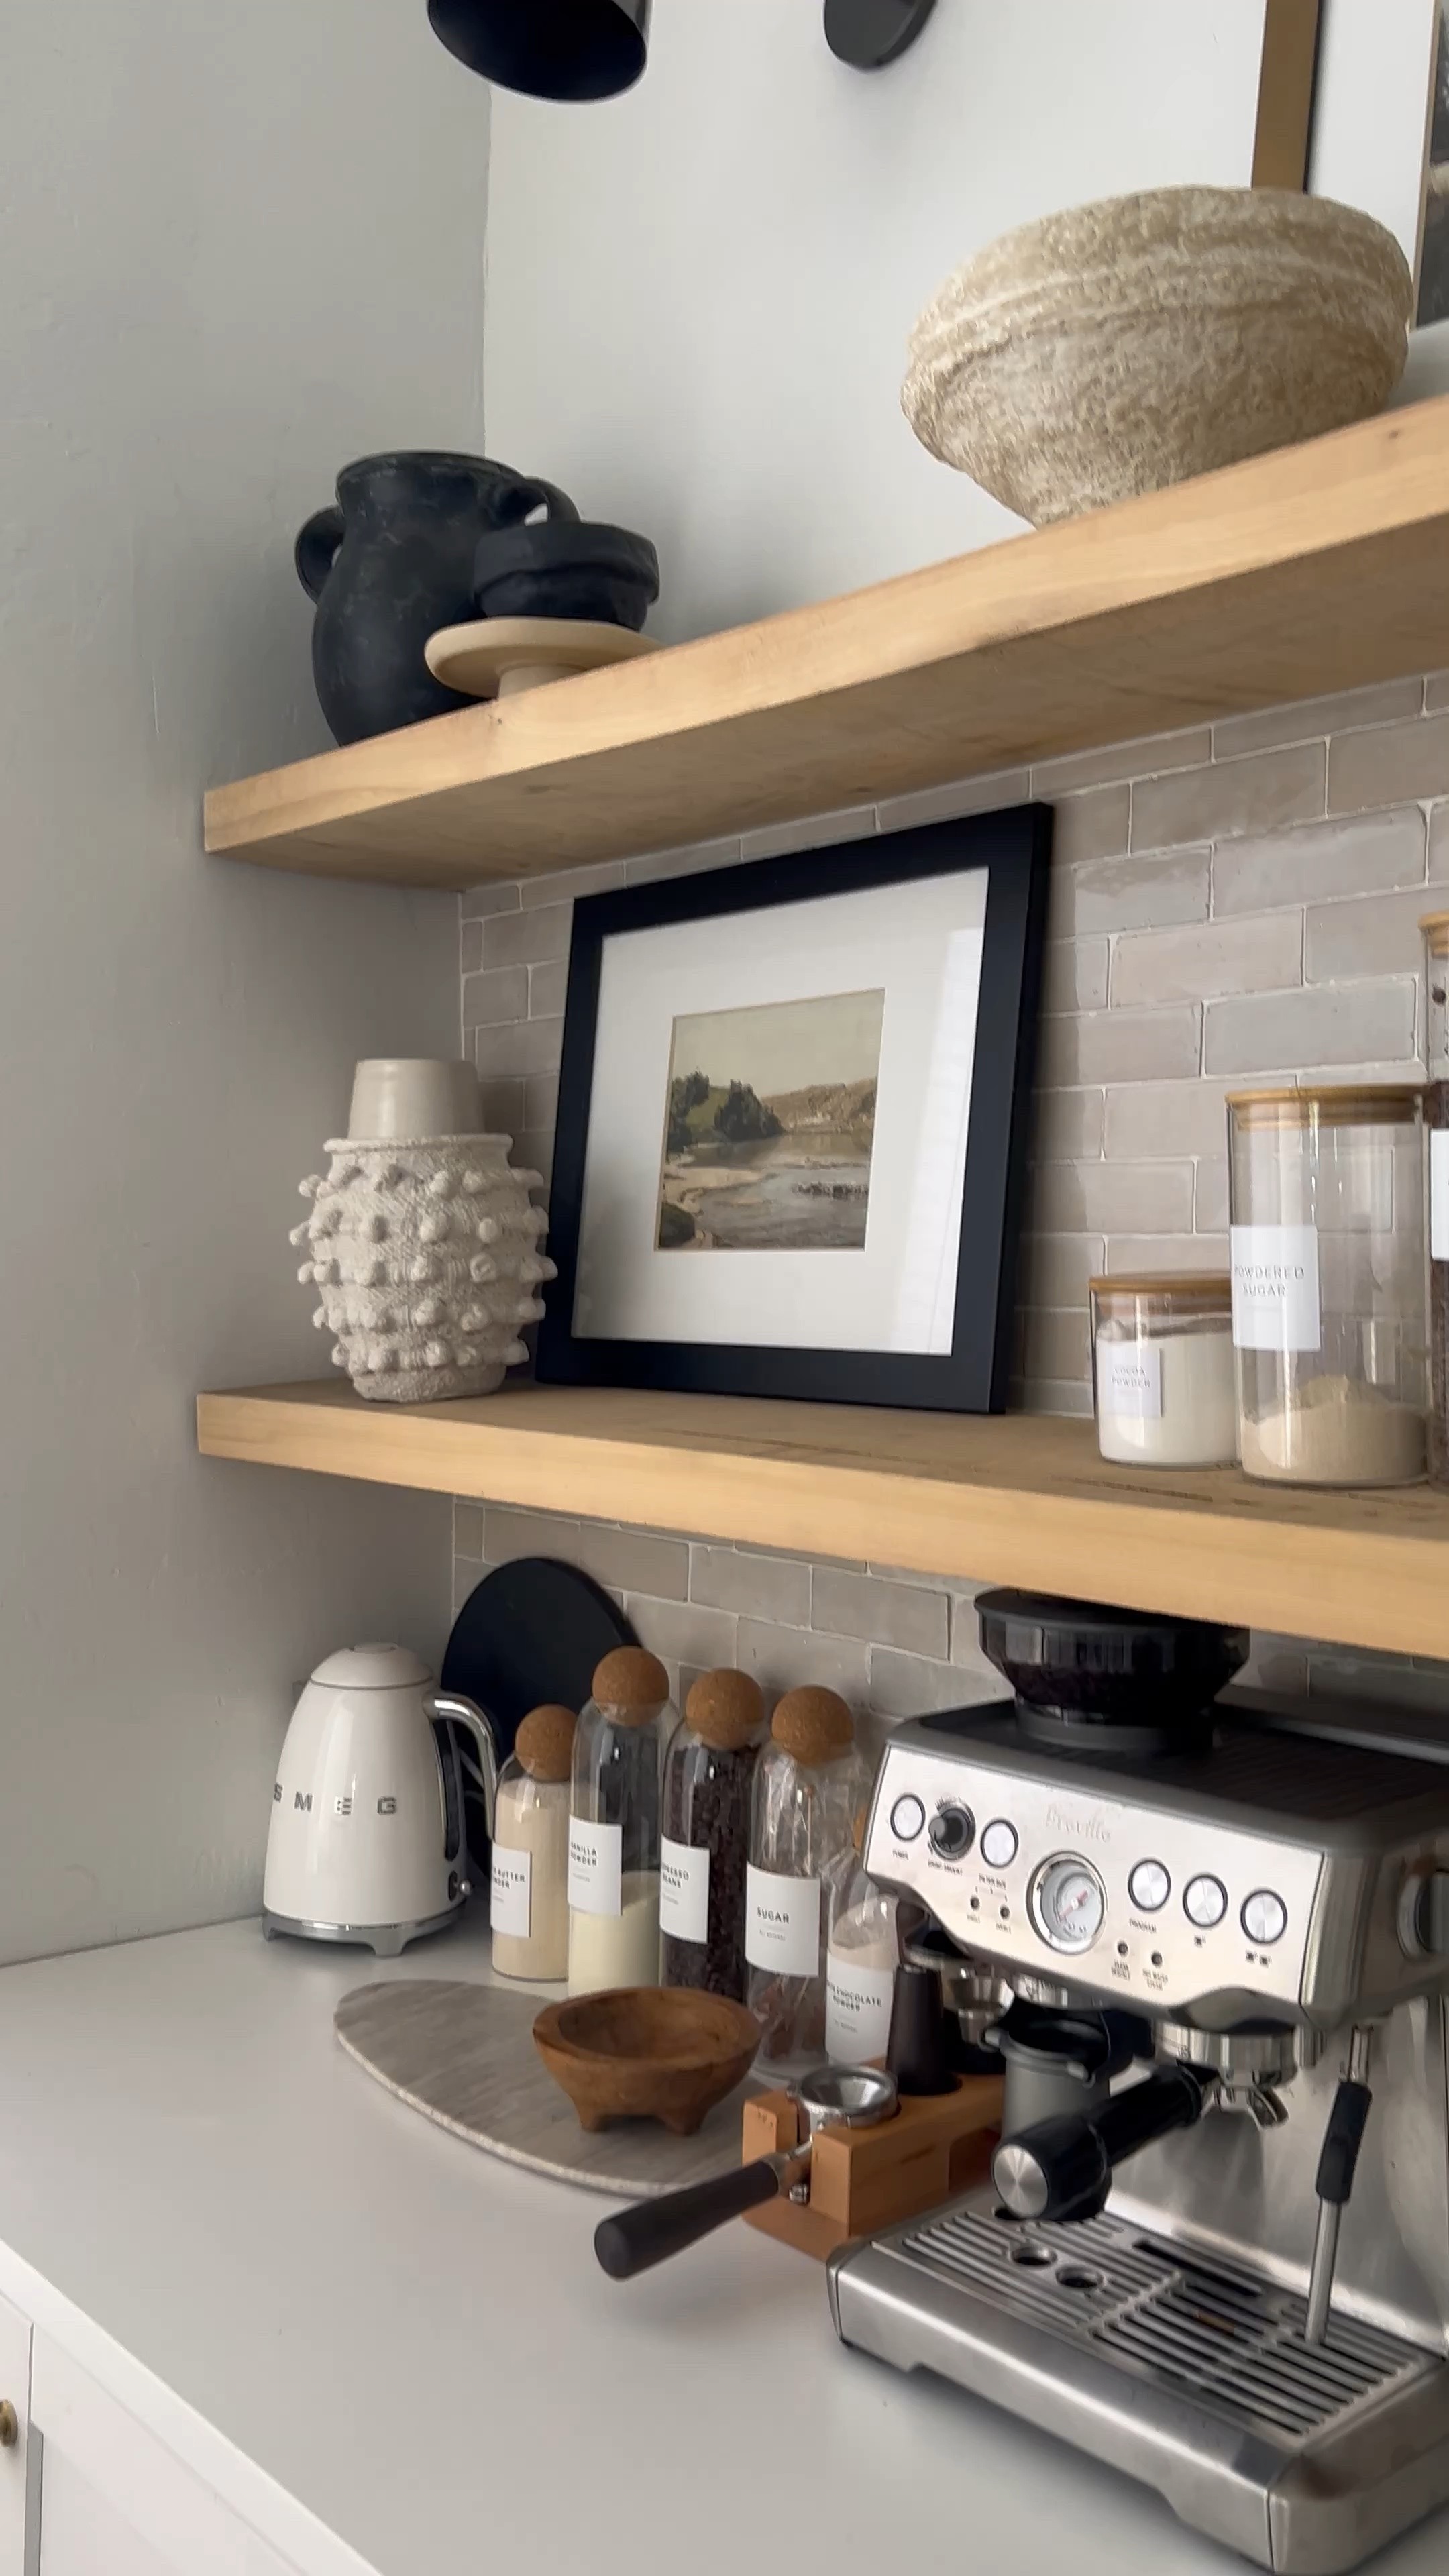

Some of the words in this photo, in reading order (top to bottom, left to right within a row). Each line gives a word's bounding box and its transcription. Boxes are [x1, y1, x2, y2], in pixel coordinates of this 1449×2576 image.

[1234, 1264, 1305, 1279] POWDERED
[1242, 1283, 1286, 1296] SUGAR
[273, 1782, 396, 1815] SMEG
[757, 1906, 790, 1924] SUGAR
